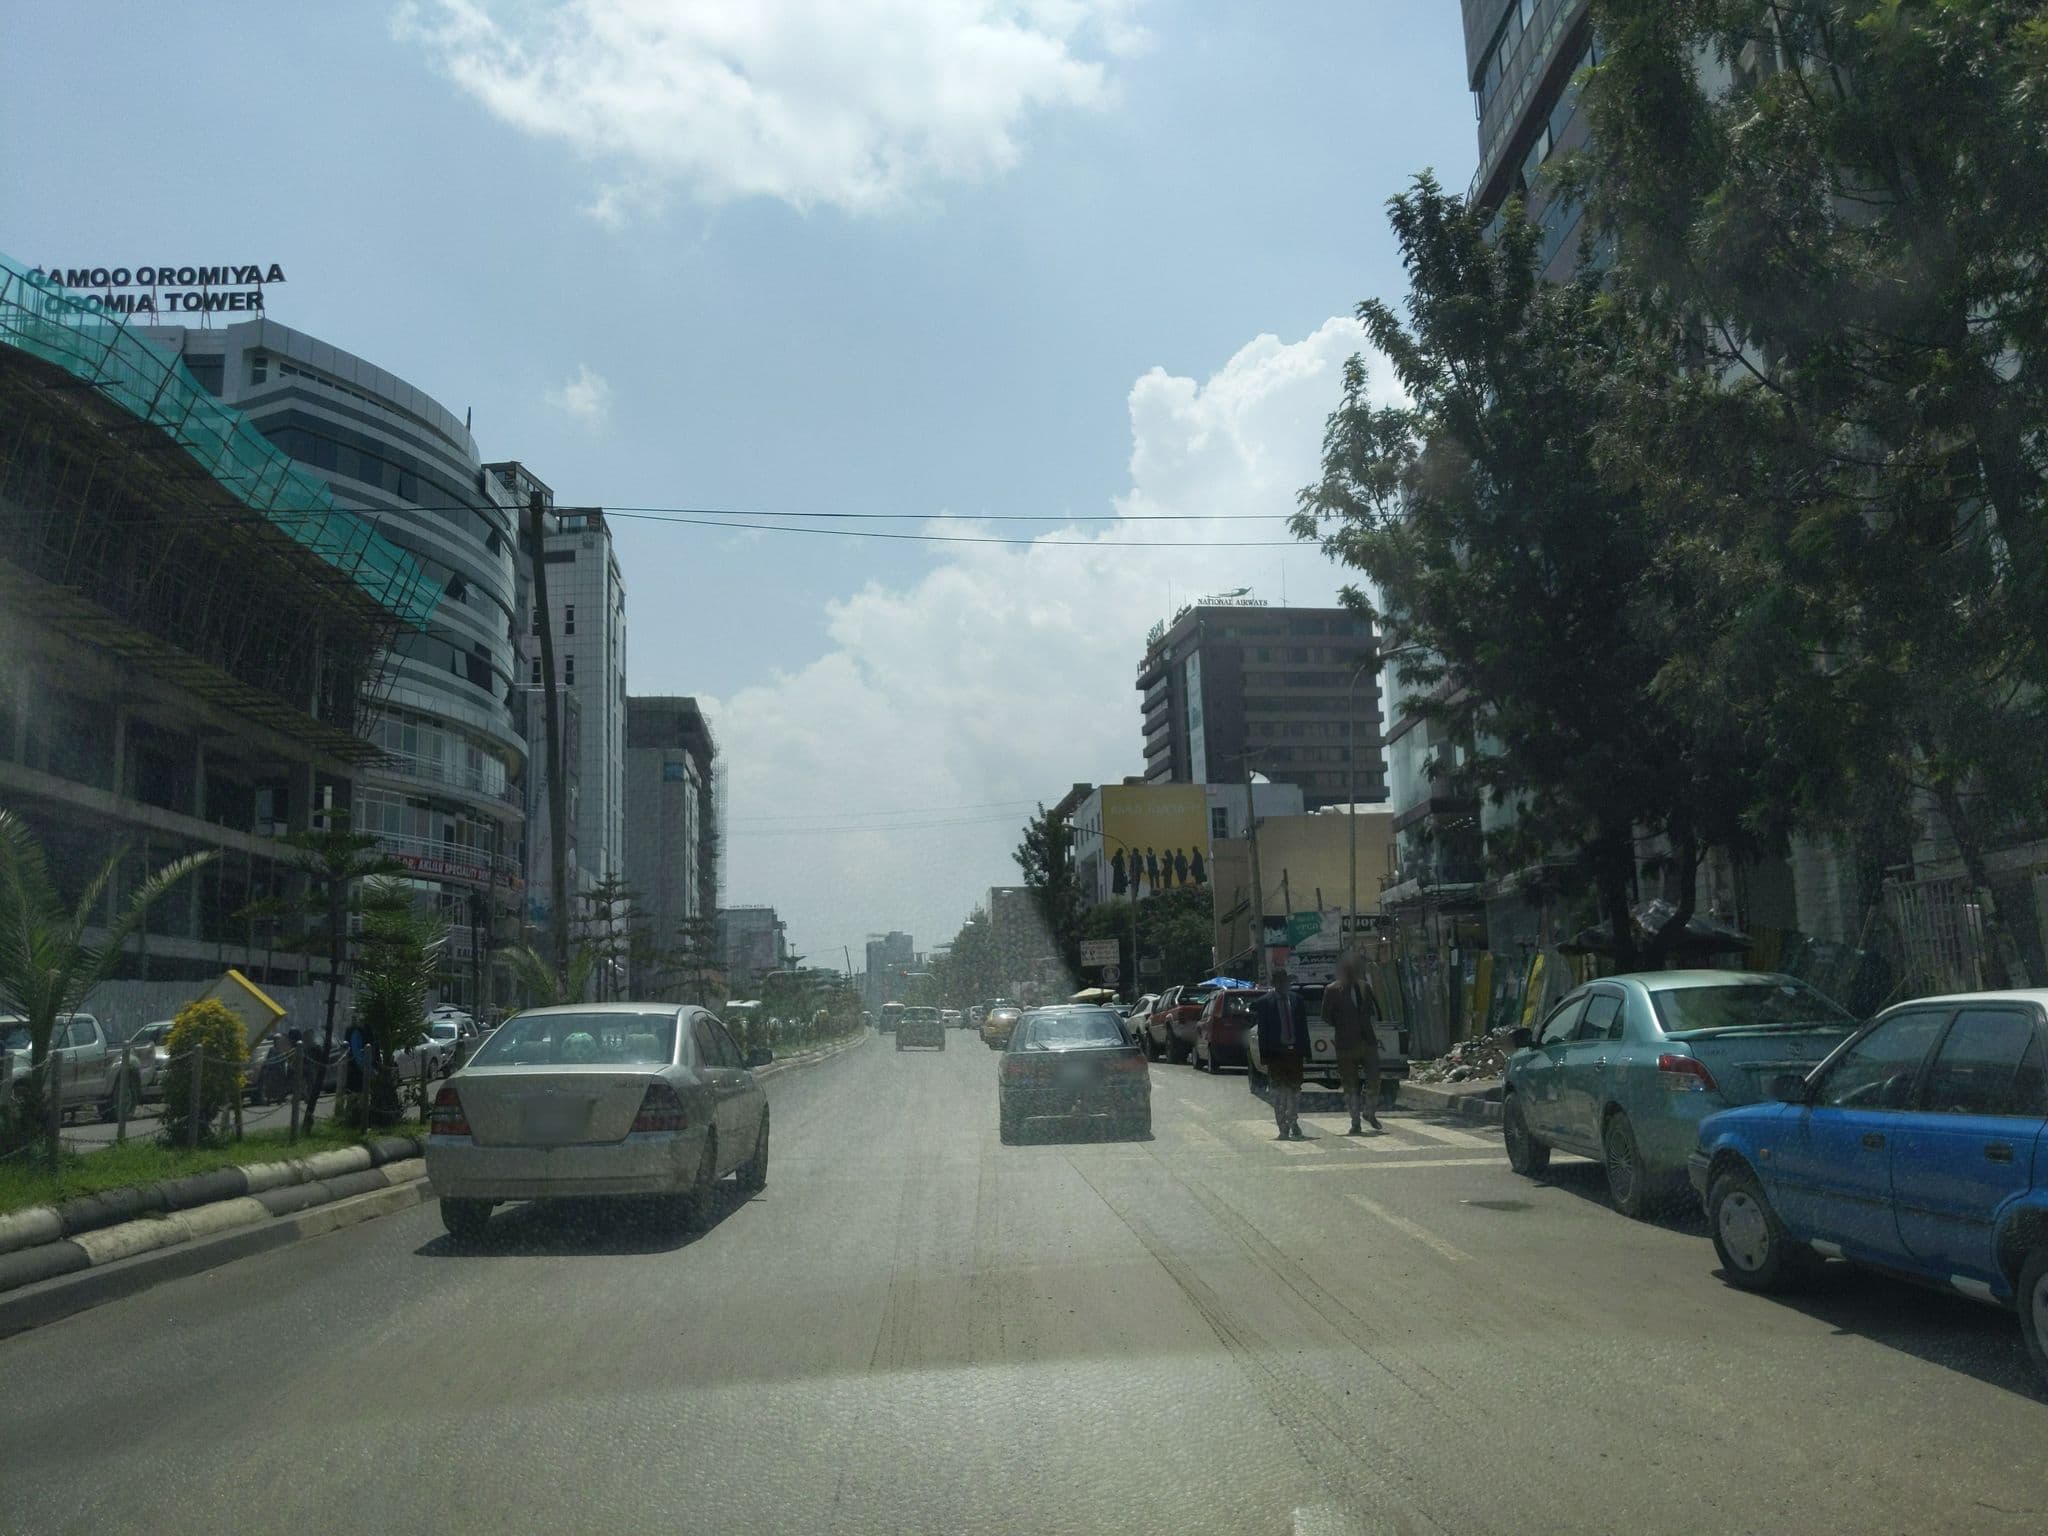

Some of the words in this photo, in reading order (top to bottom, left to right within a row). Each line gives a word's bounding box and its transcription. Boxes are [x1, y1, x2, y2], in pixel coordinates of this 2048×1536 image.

[27, 267, 131, 288] GAMOO
[136, 263, 287, 286] OROMIYAA
[45, 293, 155, 313] OROMIA
[165, 291, 265, 312] TOWER
